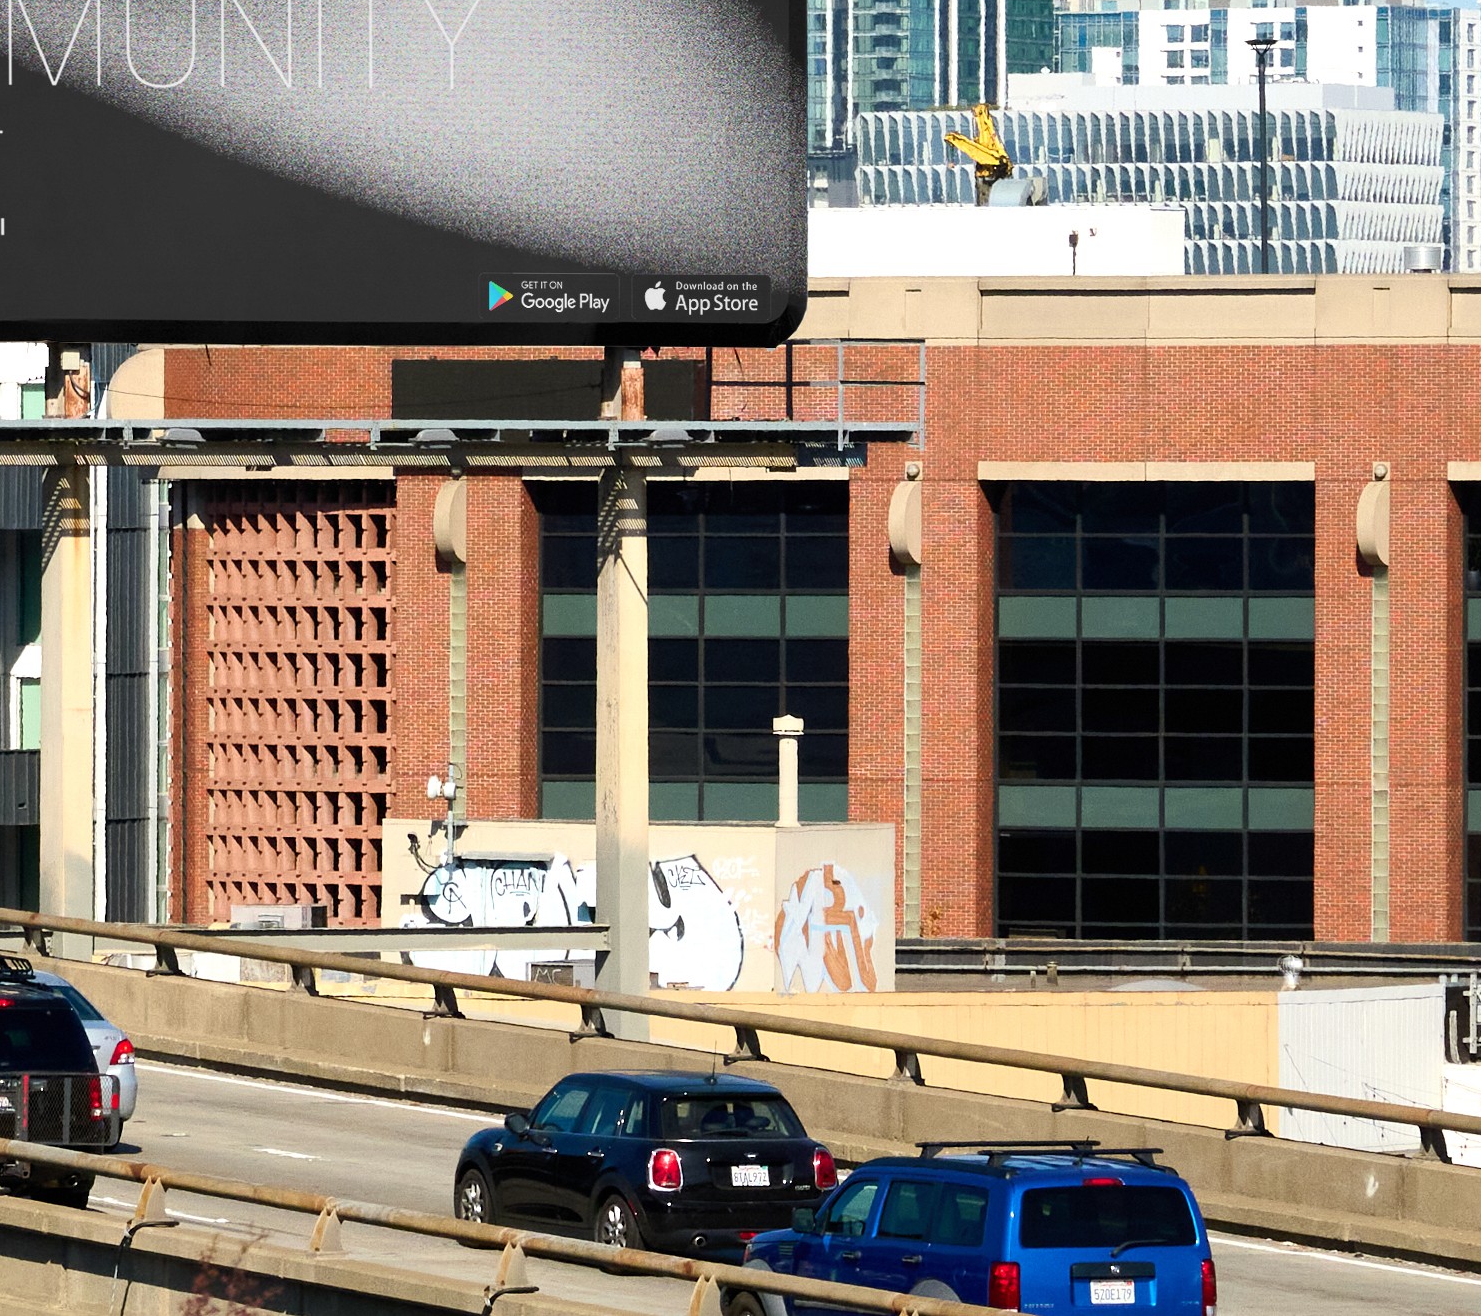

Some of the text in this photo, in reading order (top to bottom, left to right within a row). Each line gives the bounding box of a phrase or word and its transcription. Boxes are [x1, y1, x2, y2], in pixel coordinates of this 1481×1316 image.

[520, 280, 563, 290] GET IT ON
[675, 280, 758, 291] Download on the
[520, 291, 611, 313] Google Play
[674, 293, 759, 316] App Store
